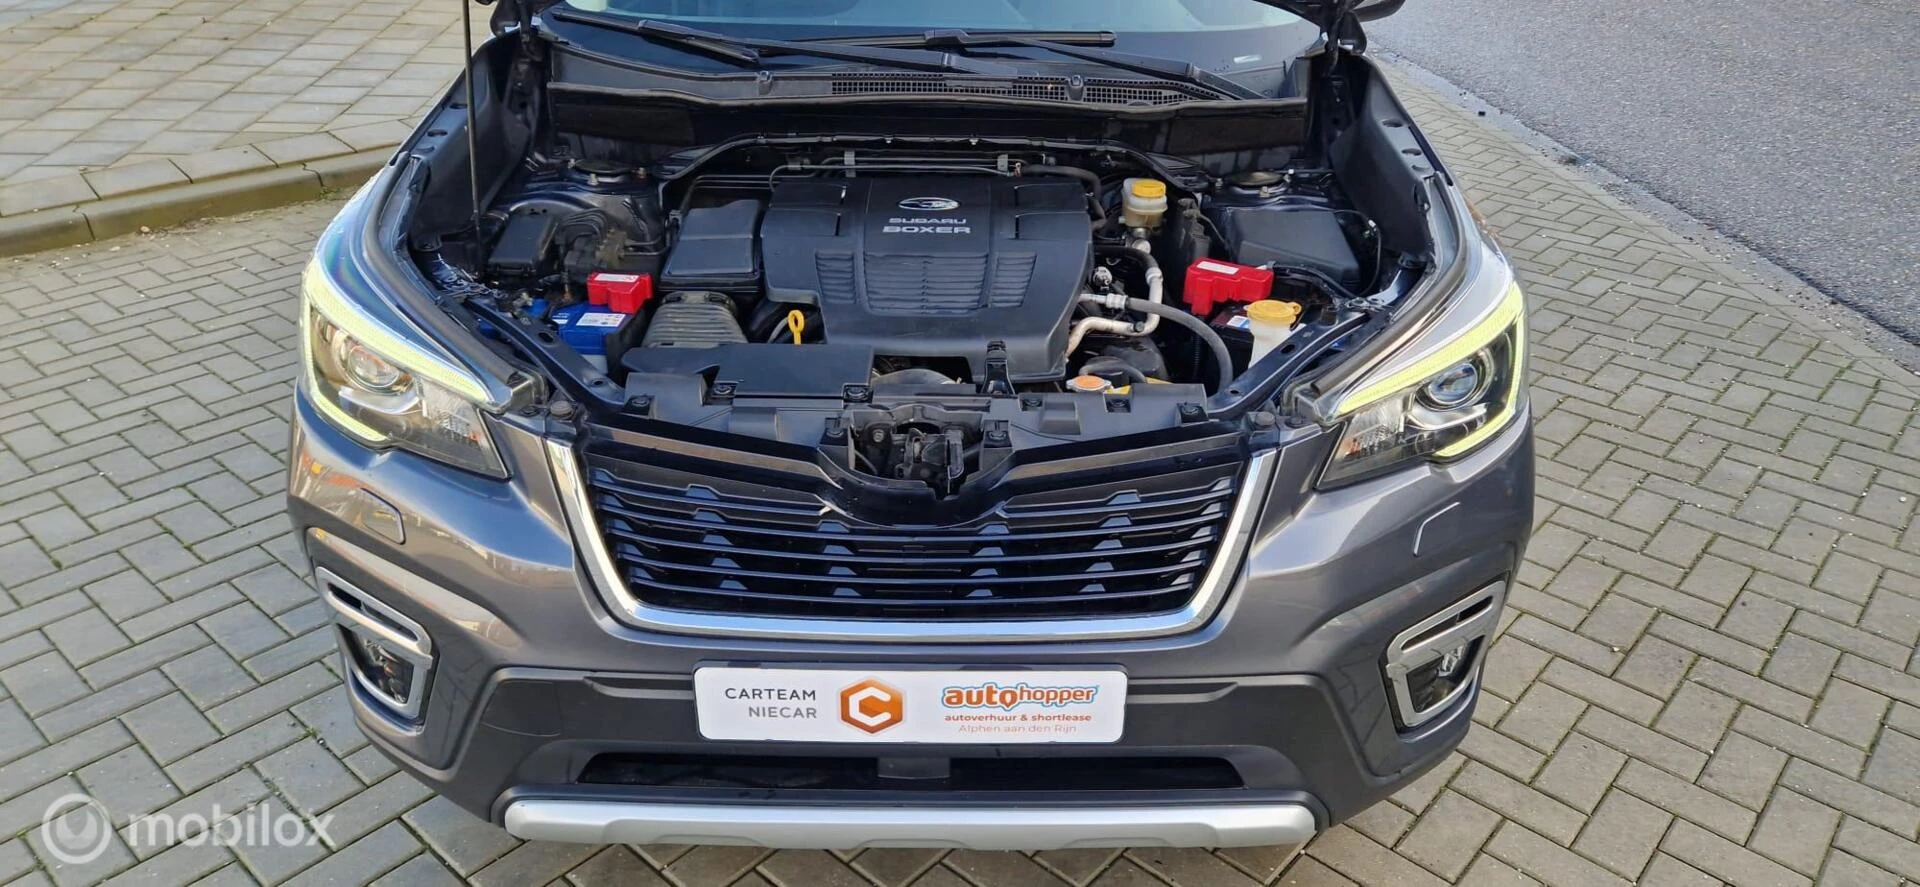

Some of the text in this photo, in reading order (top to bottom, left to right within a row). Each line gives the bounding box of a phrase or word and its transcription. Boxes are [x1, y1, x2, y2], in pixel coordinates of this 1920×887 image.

[882, 226, 971, 234] BOXER
[725, 688, 817, 701] CARTEAM
[944, 684, 1096, 709] autohopper
[748, 706, 818, 719] NIECAR
[944, 714, 1092, 722] autoverhuur & shortlease
[959, 724, 1077, 735] Alphen aan den Rijn
